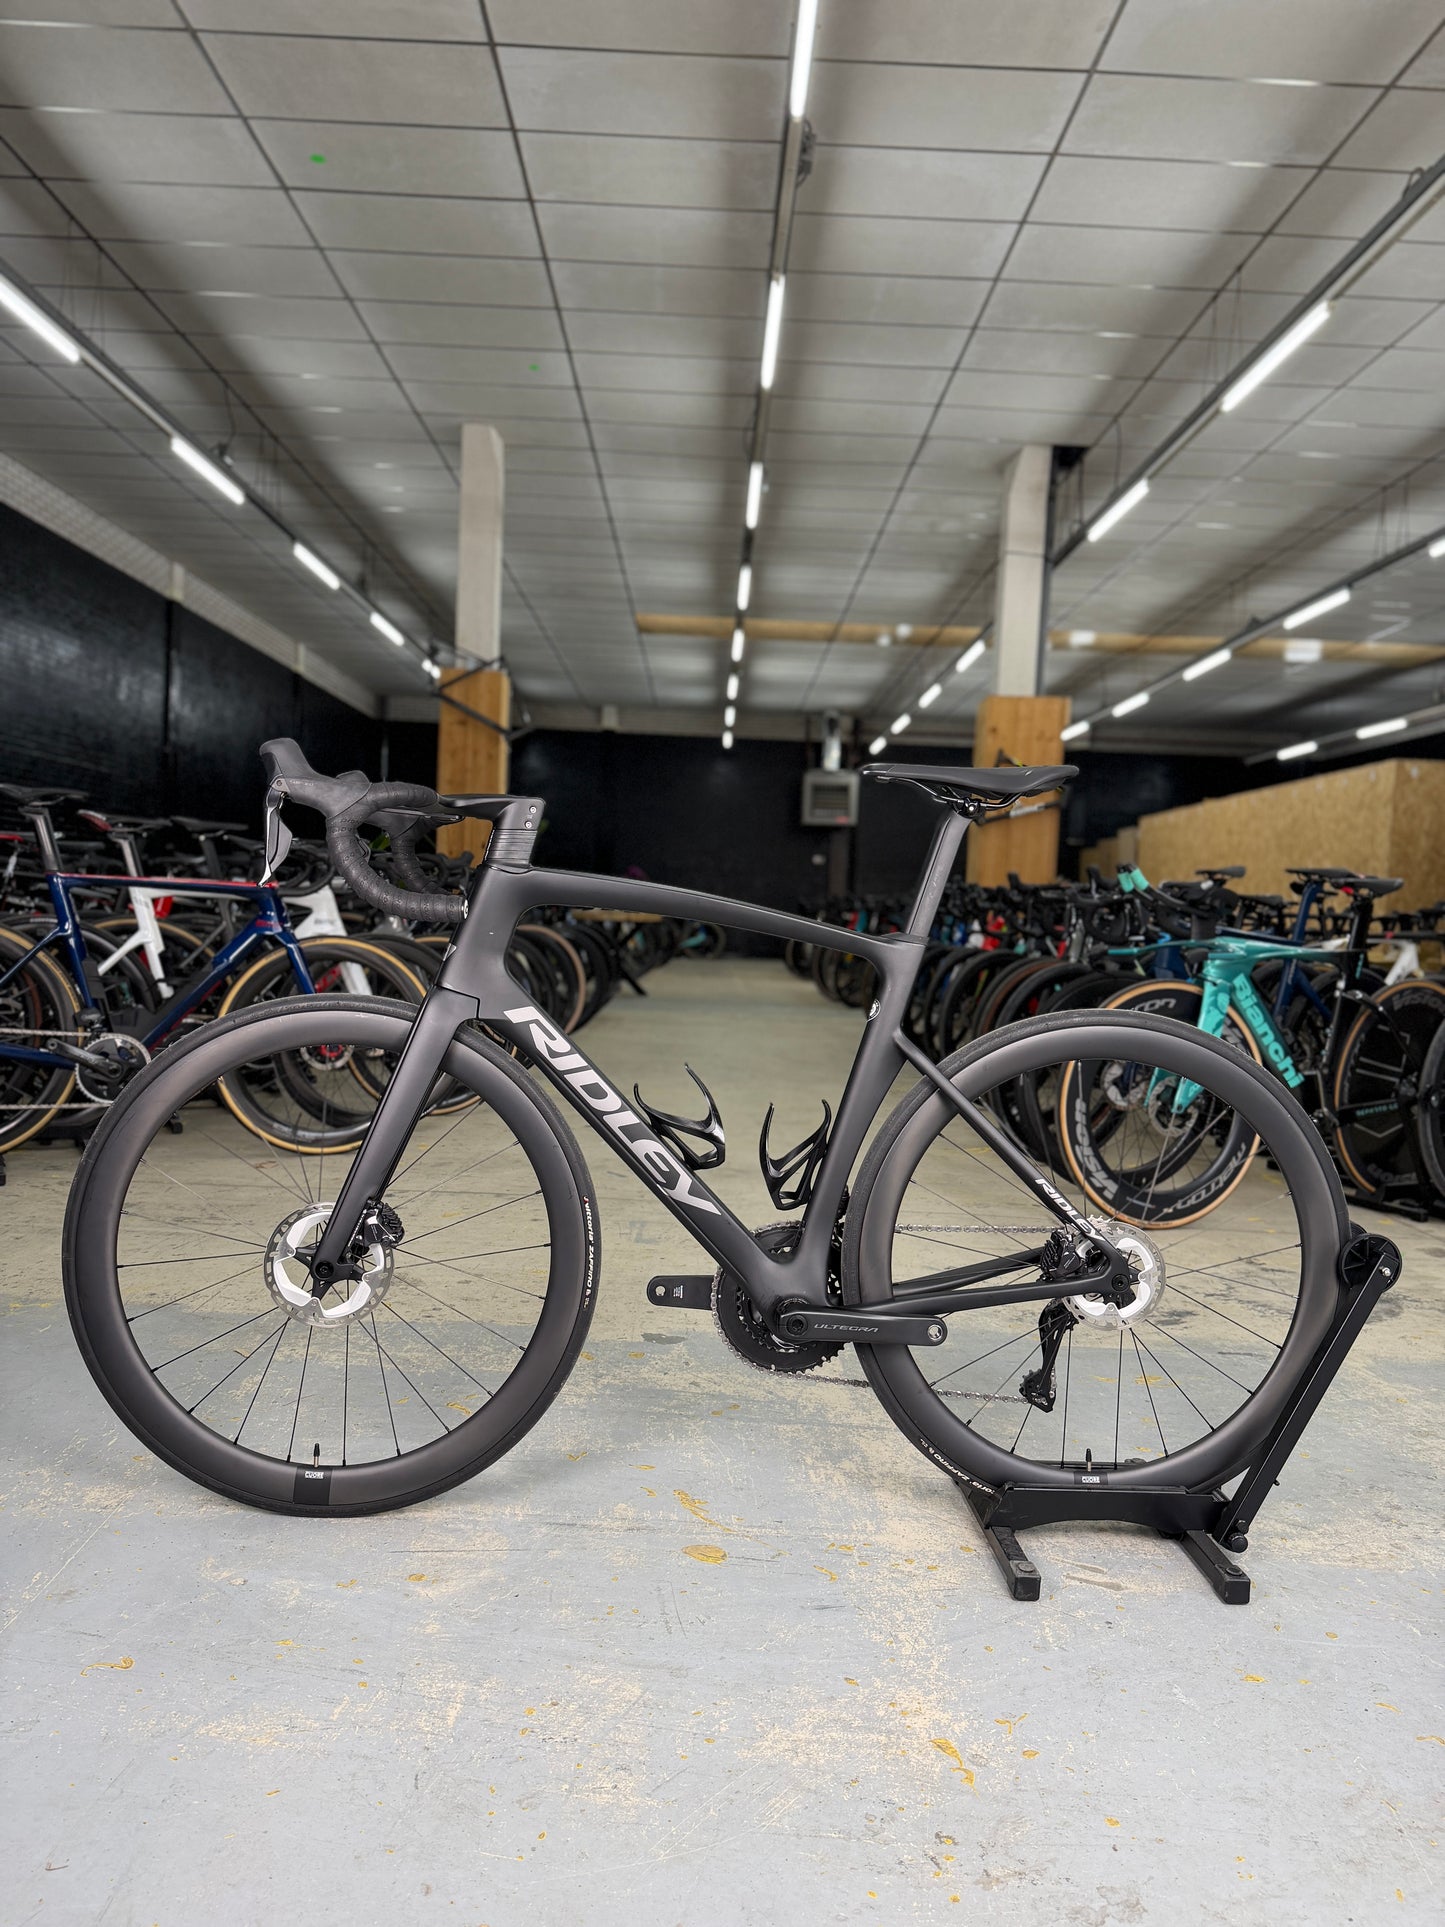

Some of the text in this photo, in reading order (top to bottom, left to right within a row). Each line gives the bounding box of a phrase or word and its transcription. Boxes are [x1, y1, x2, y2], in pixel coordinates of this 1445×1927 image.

[1233, 973, 1305, 1089] Bianchi
[503, 1006, 722, 1216] RIDLEY
[1035, 1178, 1106, 1241] RIDLEY
[814, 1323, 879, 1333] ULTEGRA
